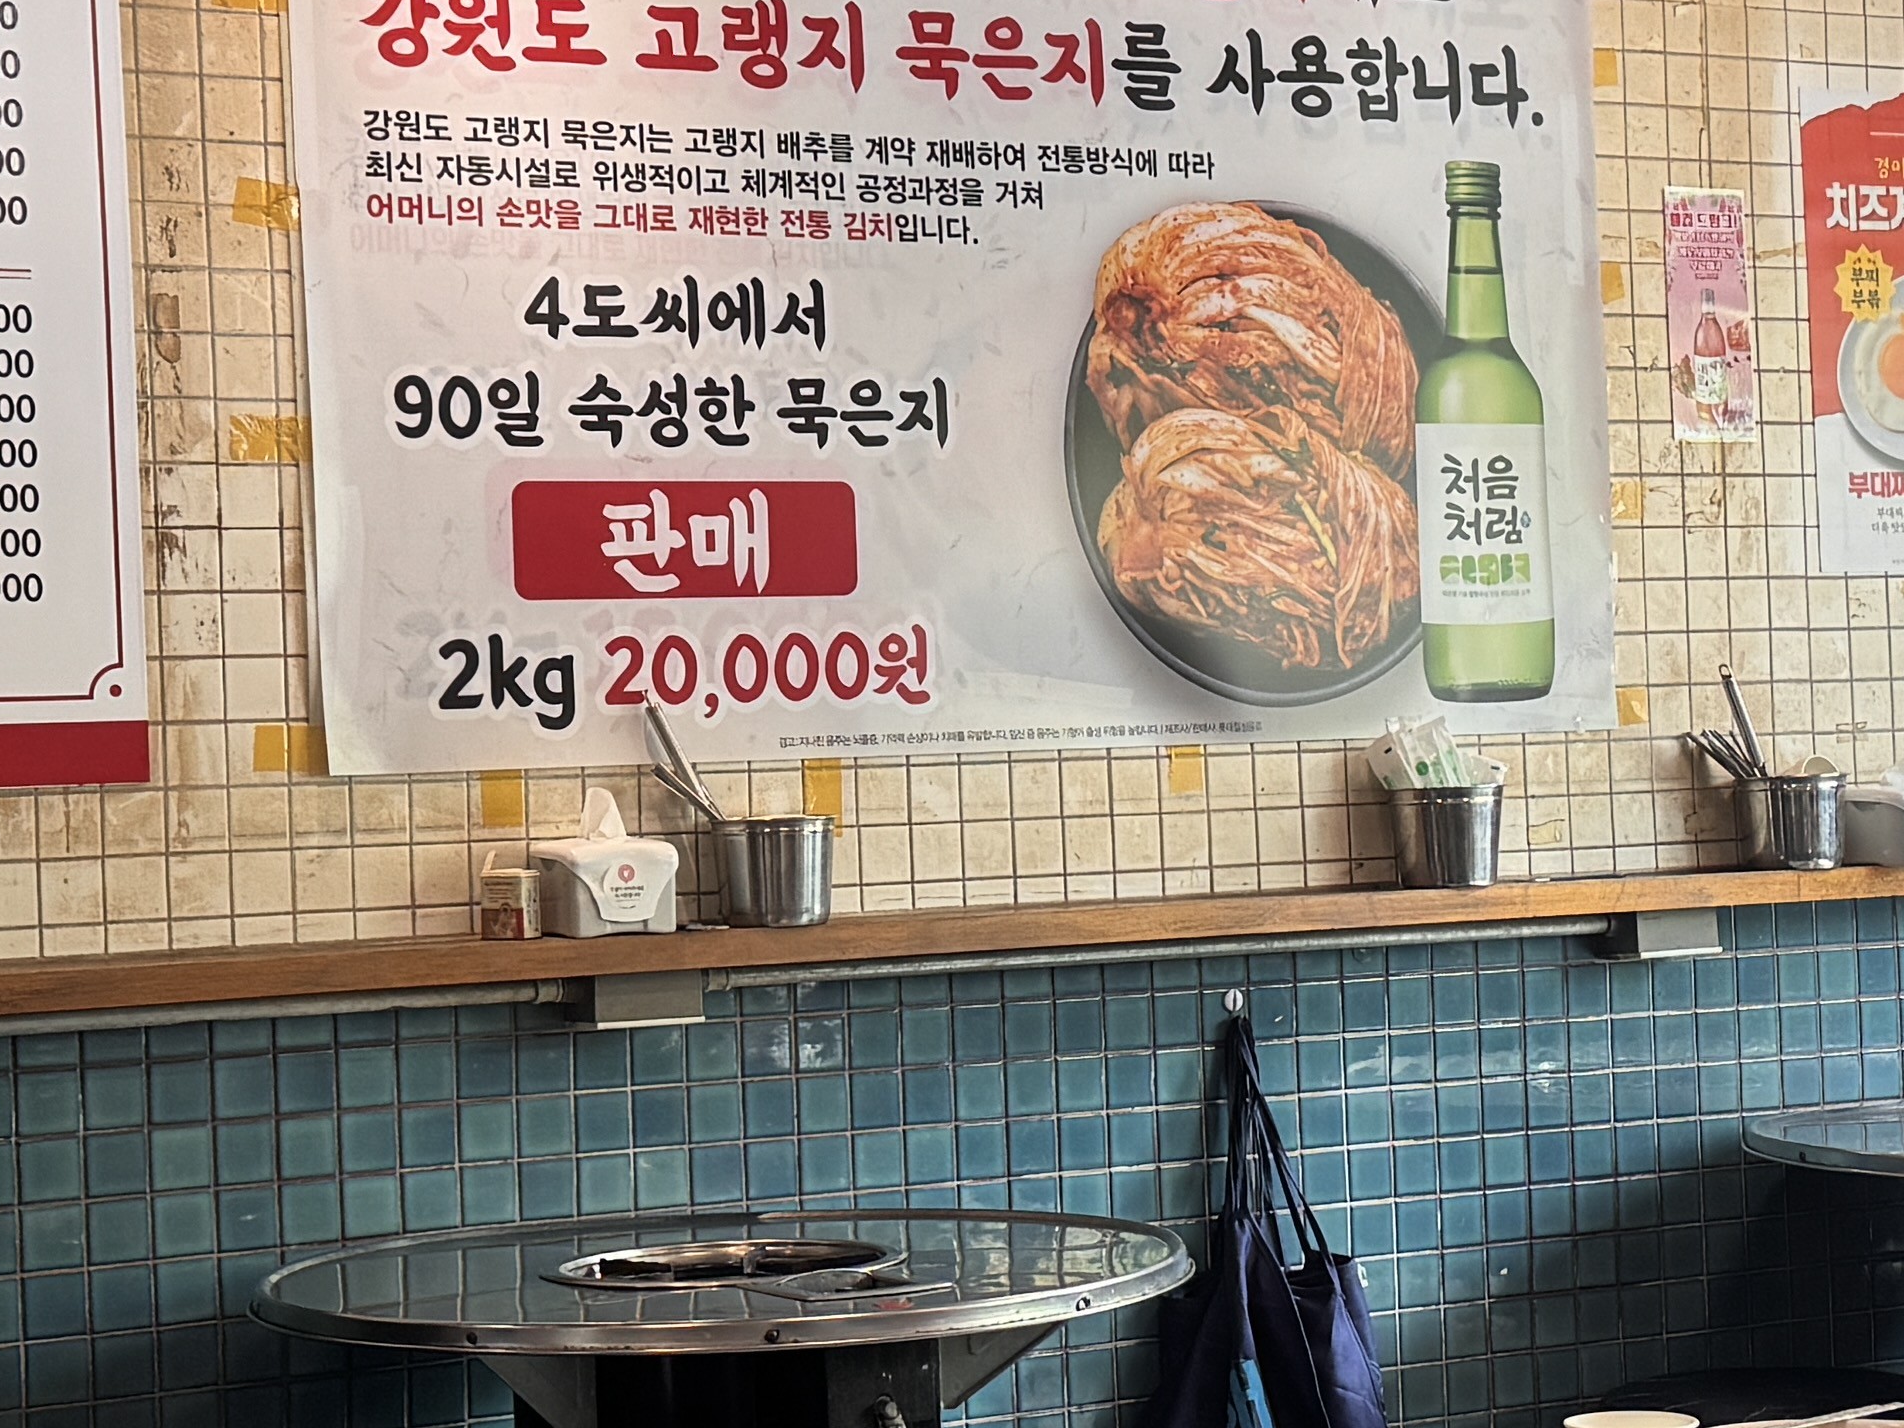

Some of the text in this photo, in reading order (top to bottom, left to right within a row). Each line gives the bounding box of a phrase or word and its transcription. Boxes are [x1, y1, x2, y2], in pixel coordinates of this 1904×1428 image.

[896, 10, 1181, 111] 묵은지를
[1206, 28, 1543, 128] 사용합니다.
[364, 110, 1215, 180] 강원도 고랭지 묵은지는 고랭지 배추를 계약 재배하여 전통방식에 따라
[366, 151, 1042, 210] 최신 자동시설로 위생적이고 체계적인 공정과정을 거쳐
[367, 193, 978, 245] 어머니의 손맛을 그대로 재현한 전통 김치입니다.
[524, 275, 825, 351] 4도씨에서
[394, 371, 948, 449] 90일 숙성한 묵은지
[1441, 454, 1519, 503] 처음
[601, 489, 769, 594] 판매
[1444, 502, 1522, 545] 처럼
[439, 622, 931, 730] 2kg 20,000원
